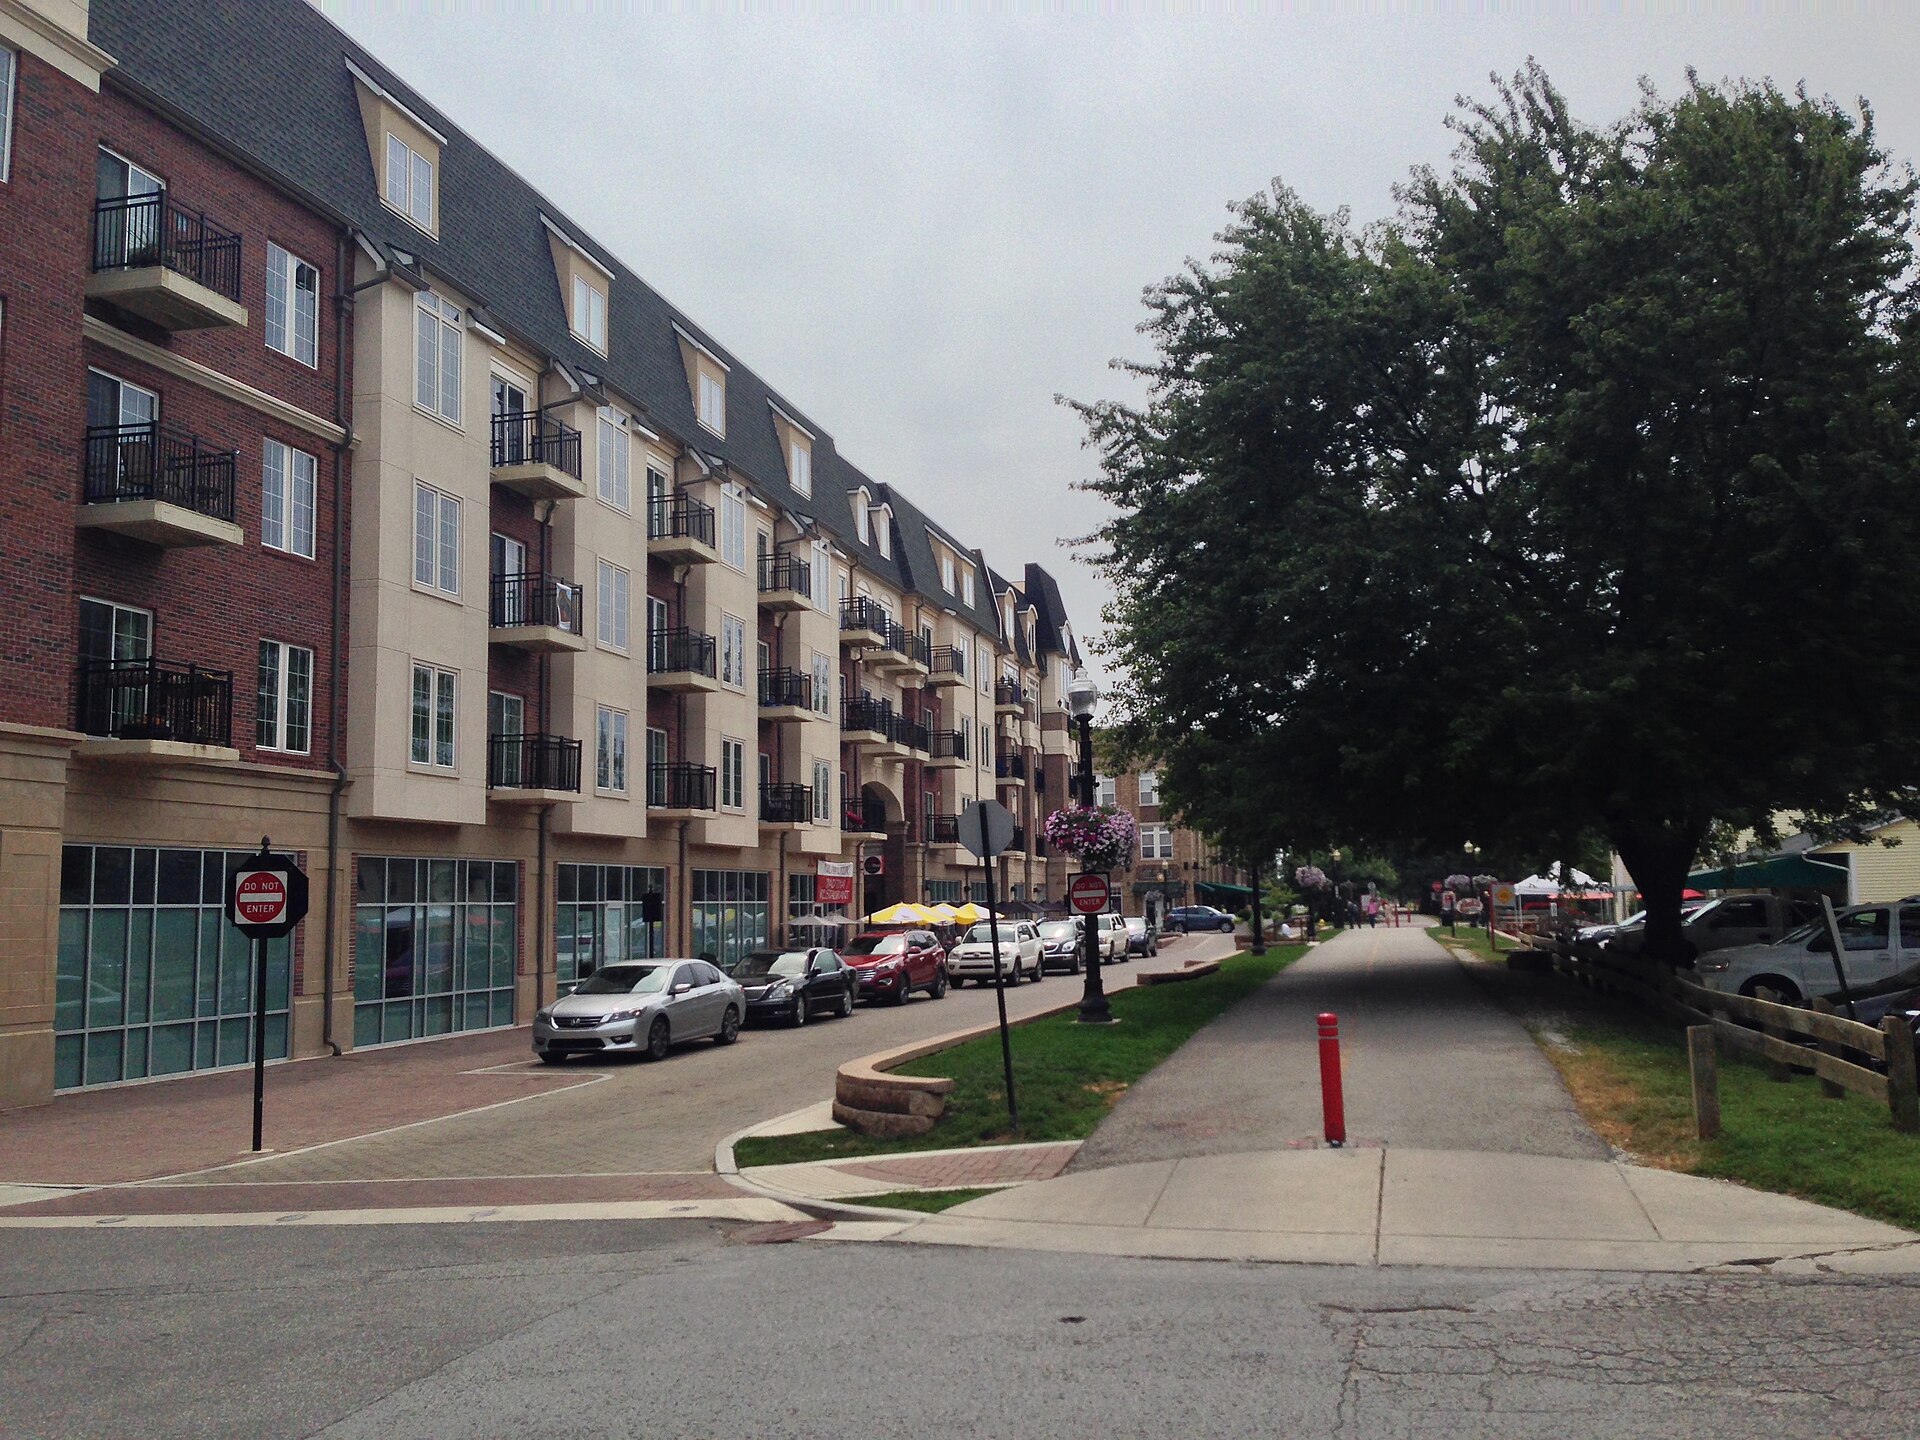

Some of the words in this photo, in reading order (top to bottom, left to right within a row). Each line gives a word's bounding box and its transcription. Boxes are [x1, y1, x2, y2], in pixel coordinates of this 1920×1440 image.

[244, 882, 257, 891] DO
[261, 882, 279, 890] NOT
[1089, 881, 1102, 889] NOT
[1080, 898, 1100, 906] ENTER
[246, 904, 275, 913] ENTER
